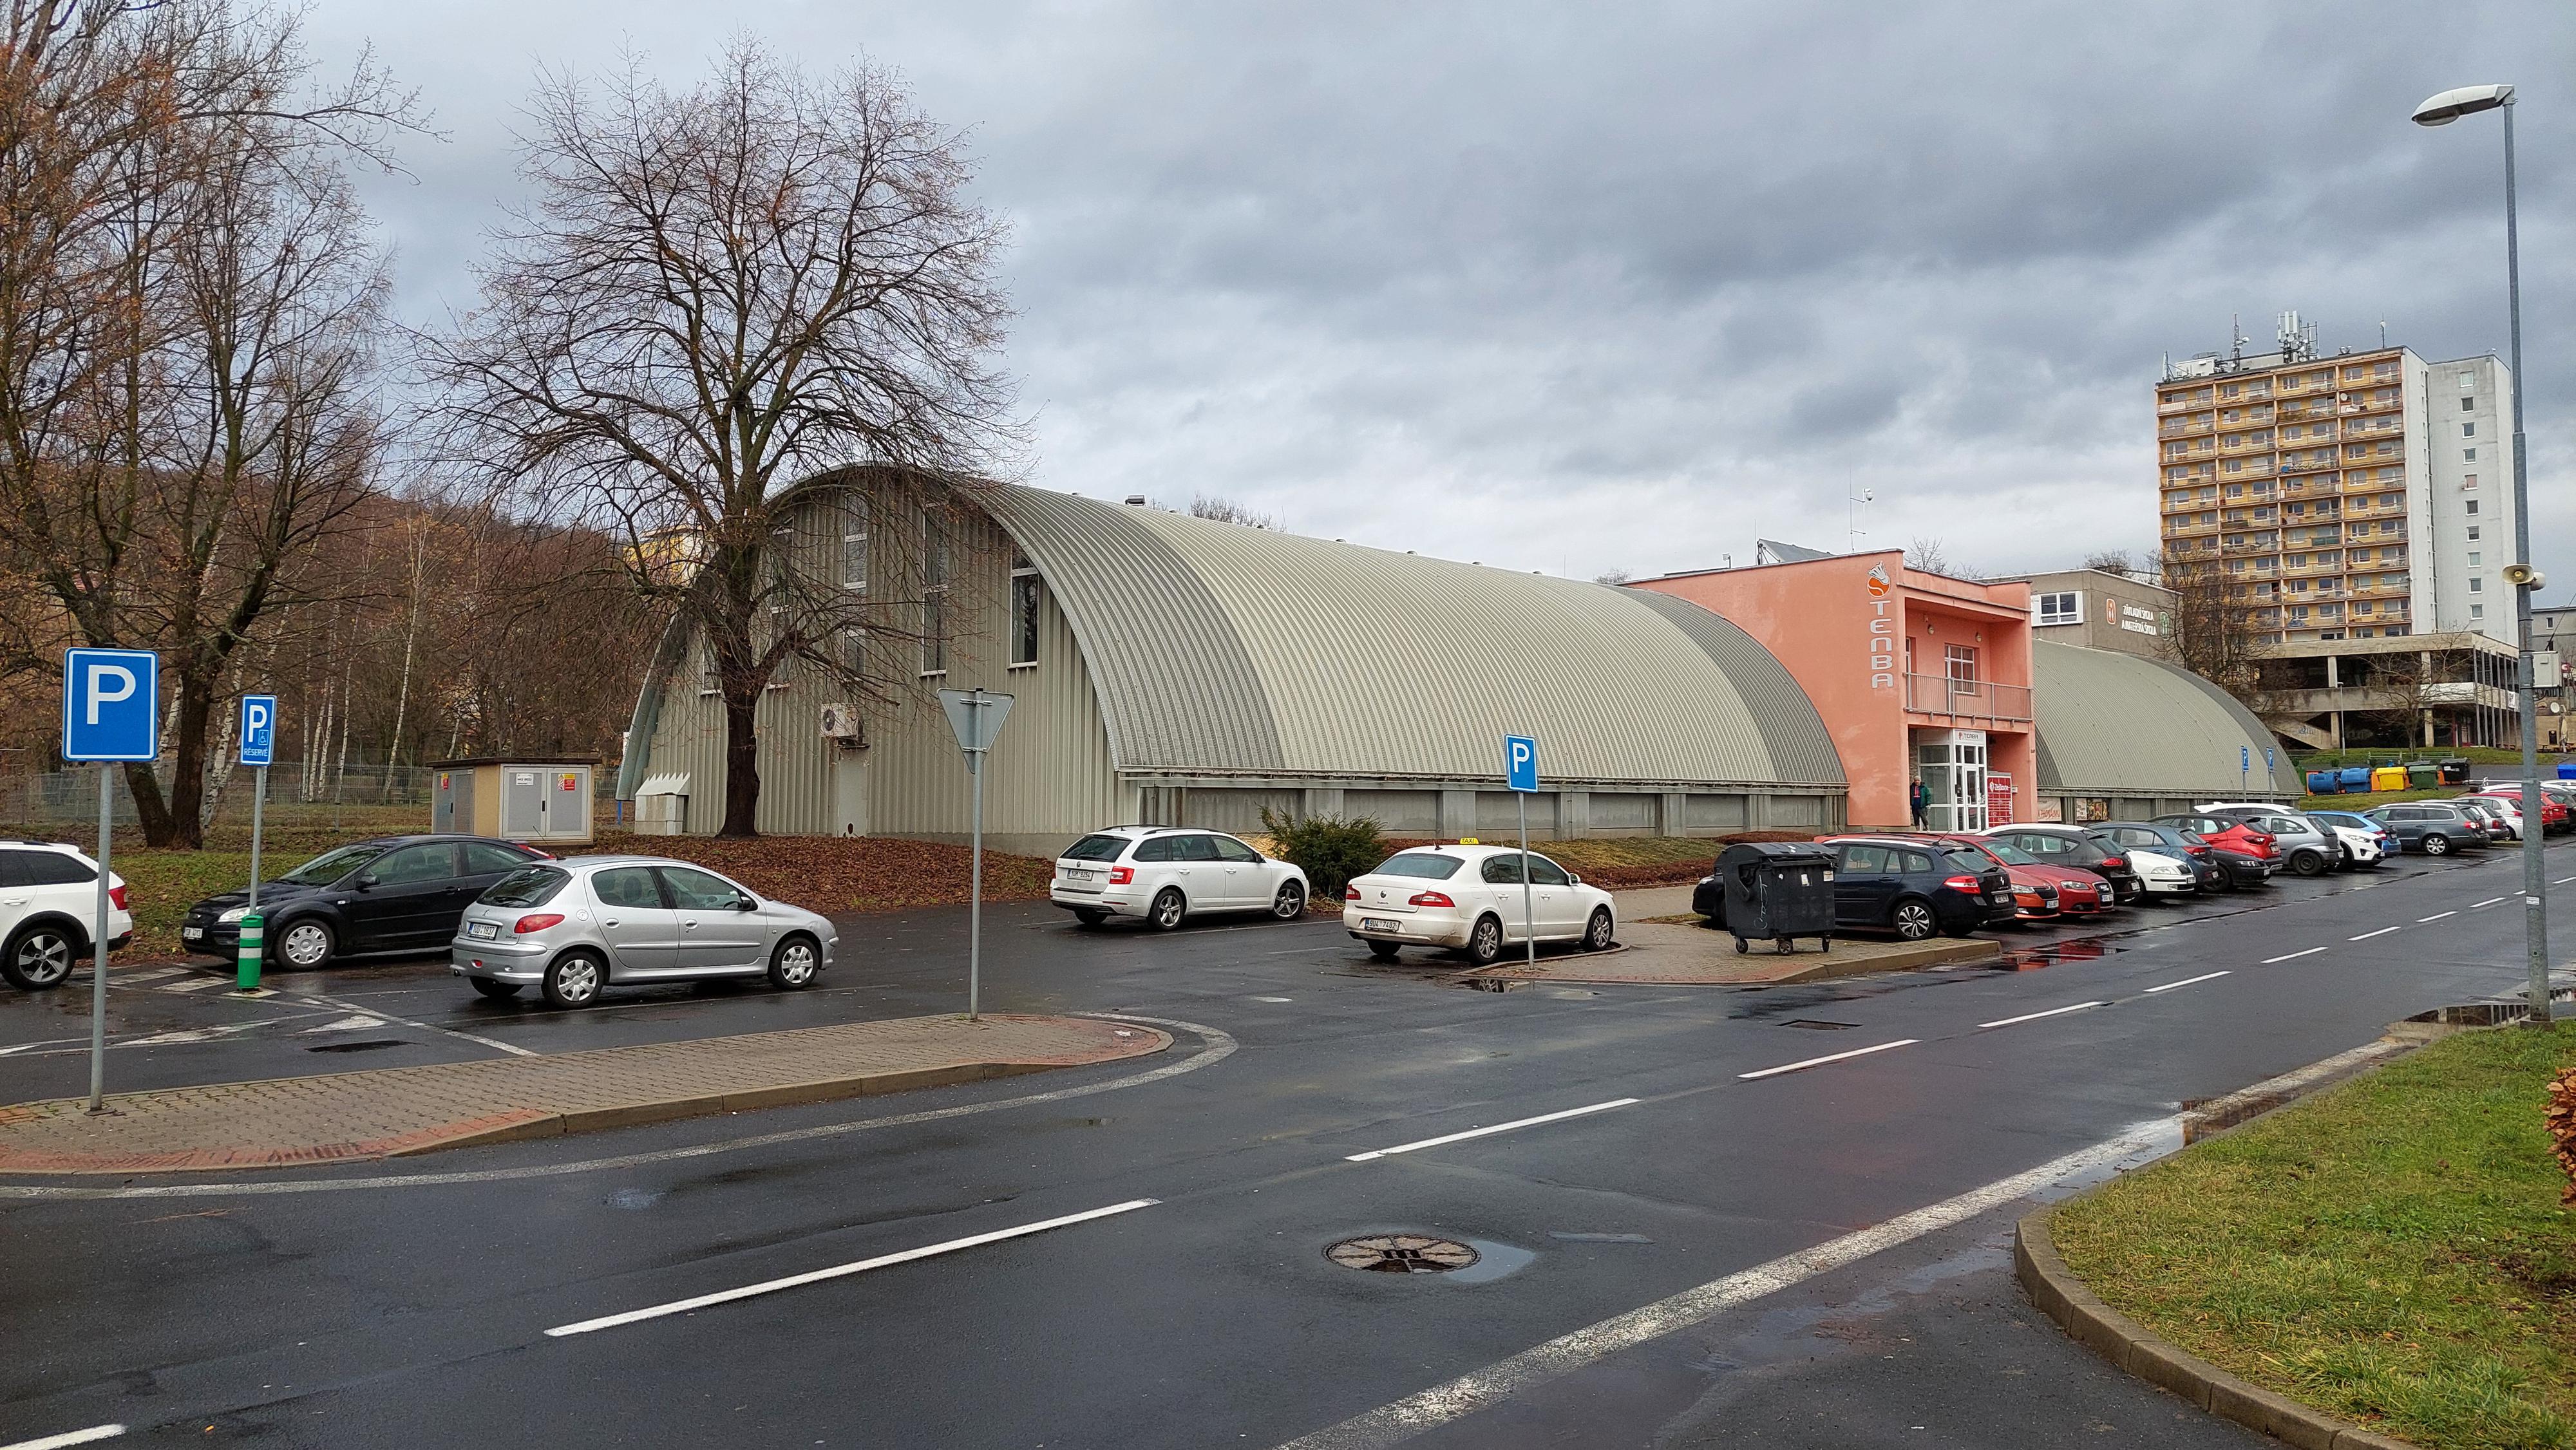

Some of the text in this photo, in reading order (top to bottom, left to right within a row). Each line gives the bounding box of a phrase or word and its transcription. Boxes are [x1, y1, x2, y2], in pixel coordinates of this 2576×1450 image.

[1870, 600, 1894, 688] TENBA
[87, 664, 137, 724] P
[248, 704, 267, 742] P
[1512, 742, 1530, 773] P
[2243, 750, 2248, 764] P
[484, 925, 495, 936] 1937
